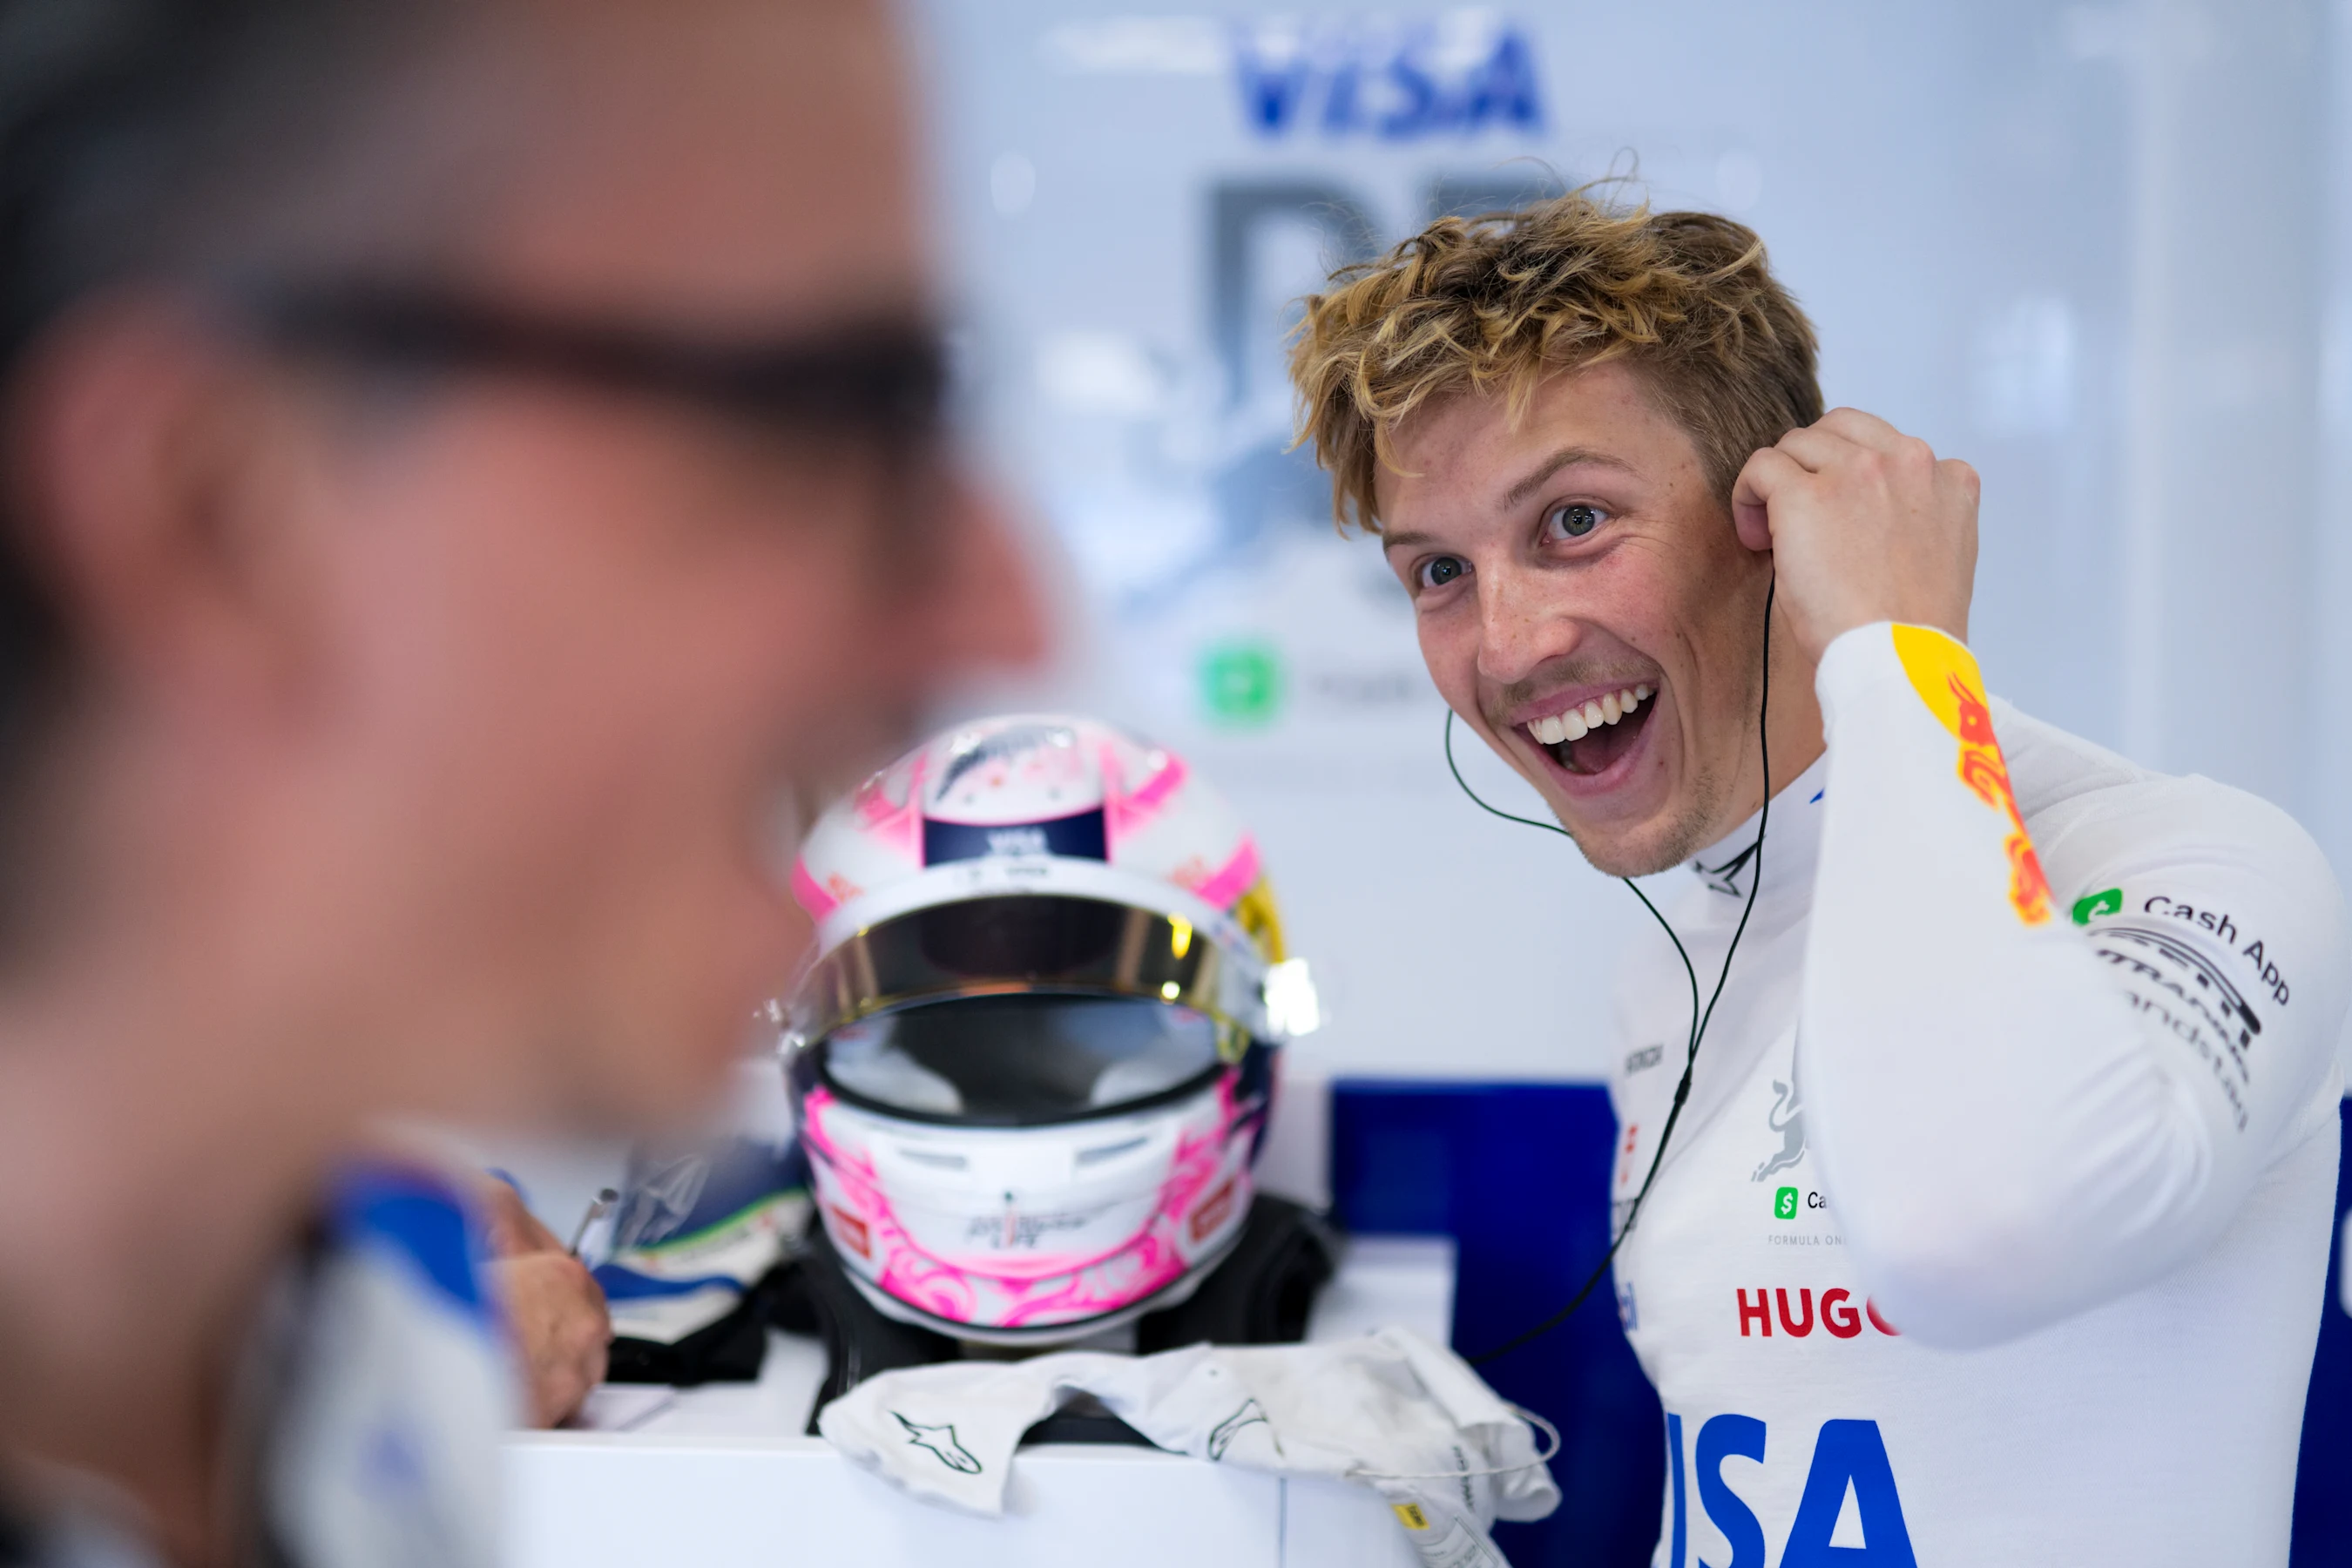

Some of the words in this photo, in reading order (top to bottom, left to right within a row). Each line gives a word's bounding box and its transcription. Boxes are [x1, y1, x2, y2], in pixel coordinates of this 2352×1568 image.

[1230, 21, 1546, 137] VISA
[2144, 896, 2237, 944] Cash
[2242, 940, 2289, 1006] App
[1767, 1234, 1821, 1246] FORMULA
[1825, 1234, 1846, 1246] ON
[1807, 1191, 1828, 1209] Ca
[1666, 1412, 1918, 1568] ISA
